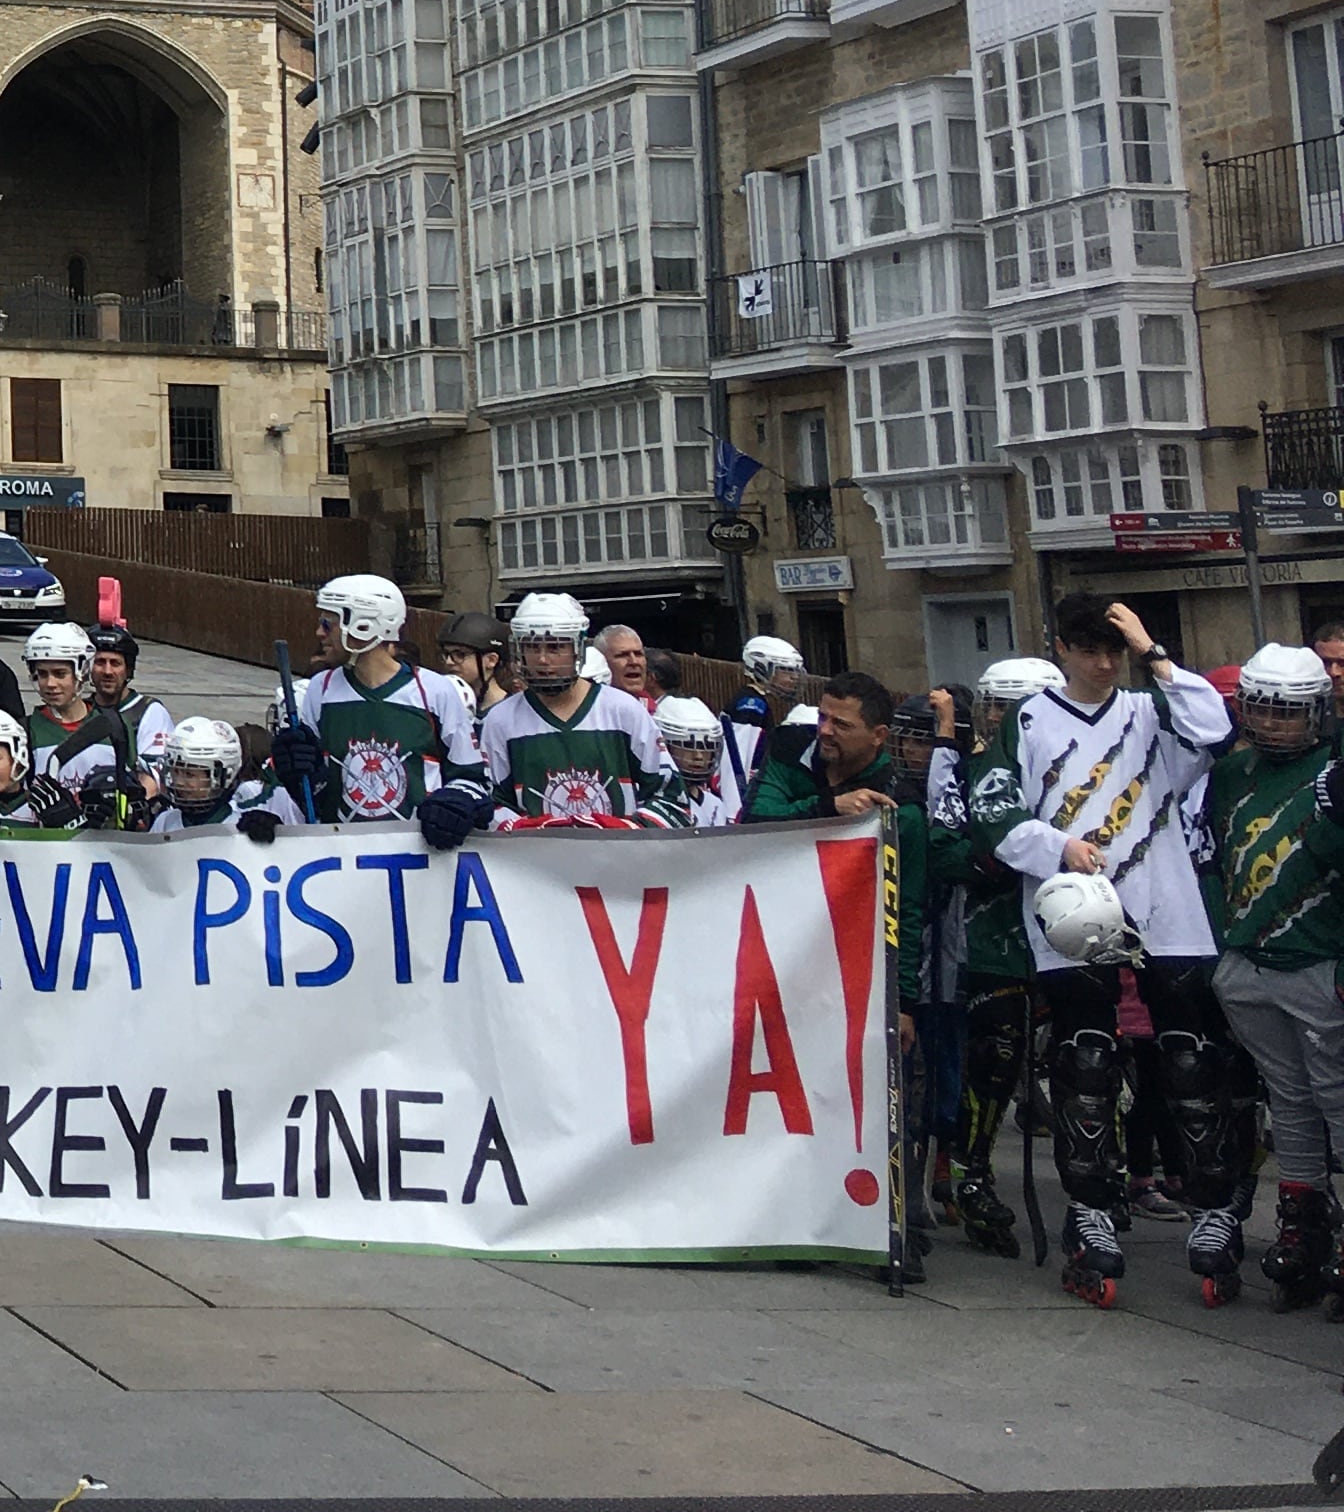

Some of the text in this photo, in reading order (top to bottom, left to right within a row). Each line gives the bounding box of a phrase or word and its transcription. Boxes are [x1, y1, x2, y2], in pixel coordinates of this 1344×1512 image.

[779, 566, 803, 586] BAR
[1228, 562, 1304, 586] VIORIA
[882, 843, 900, 949] CCM
